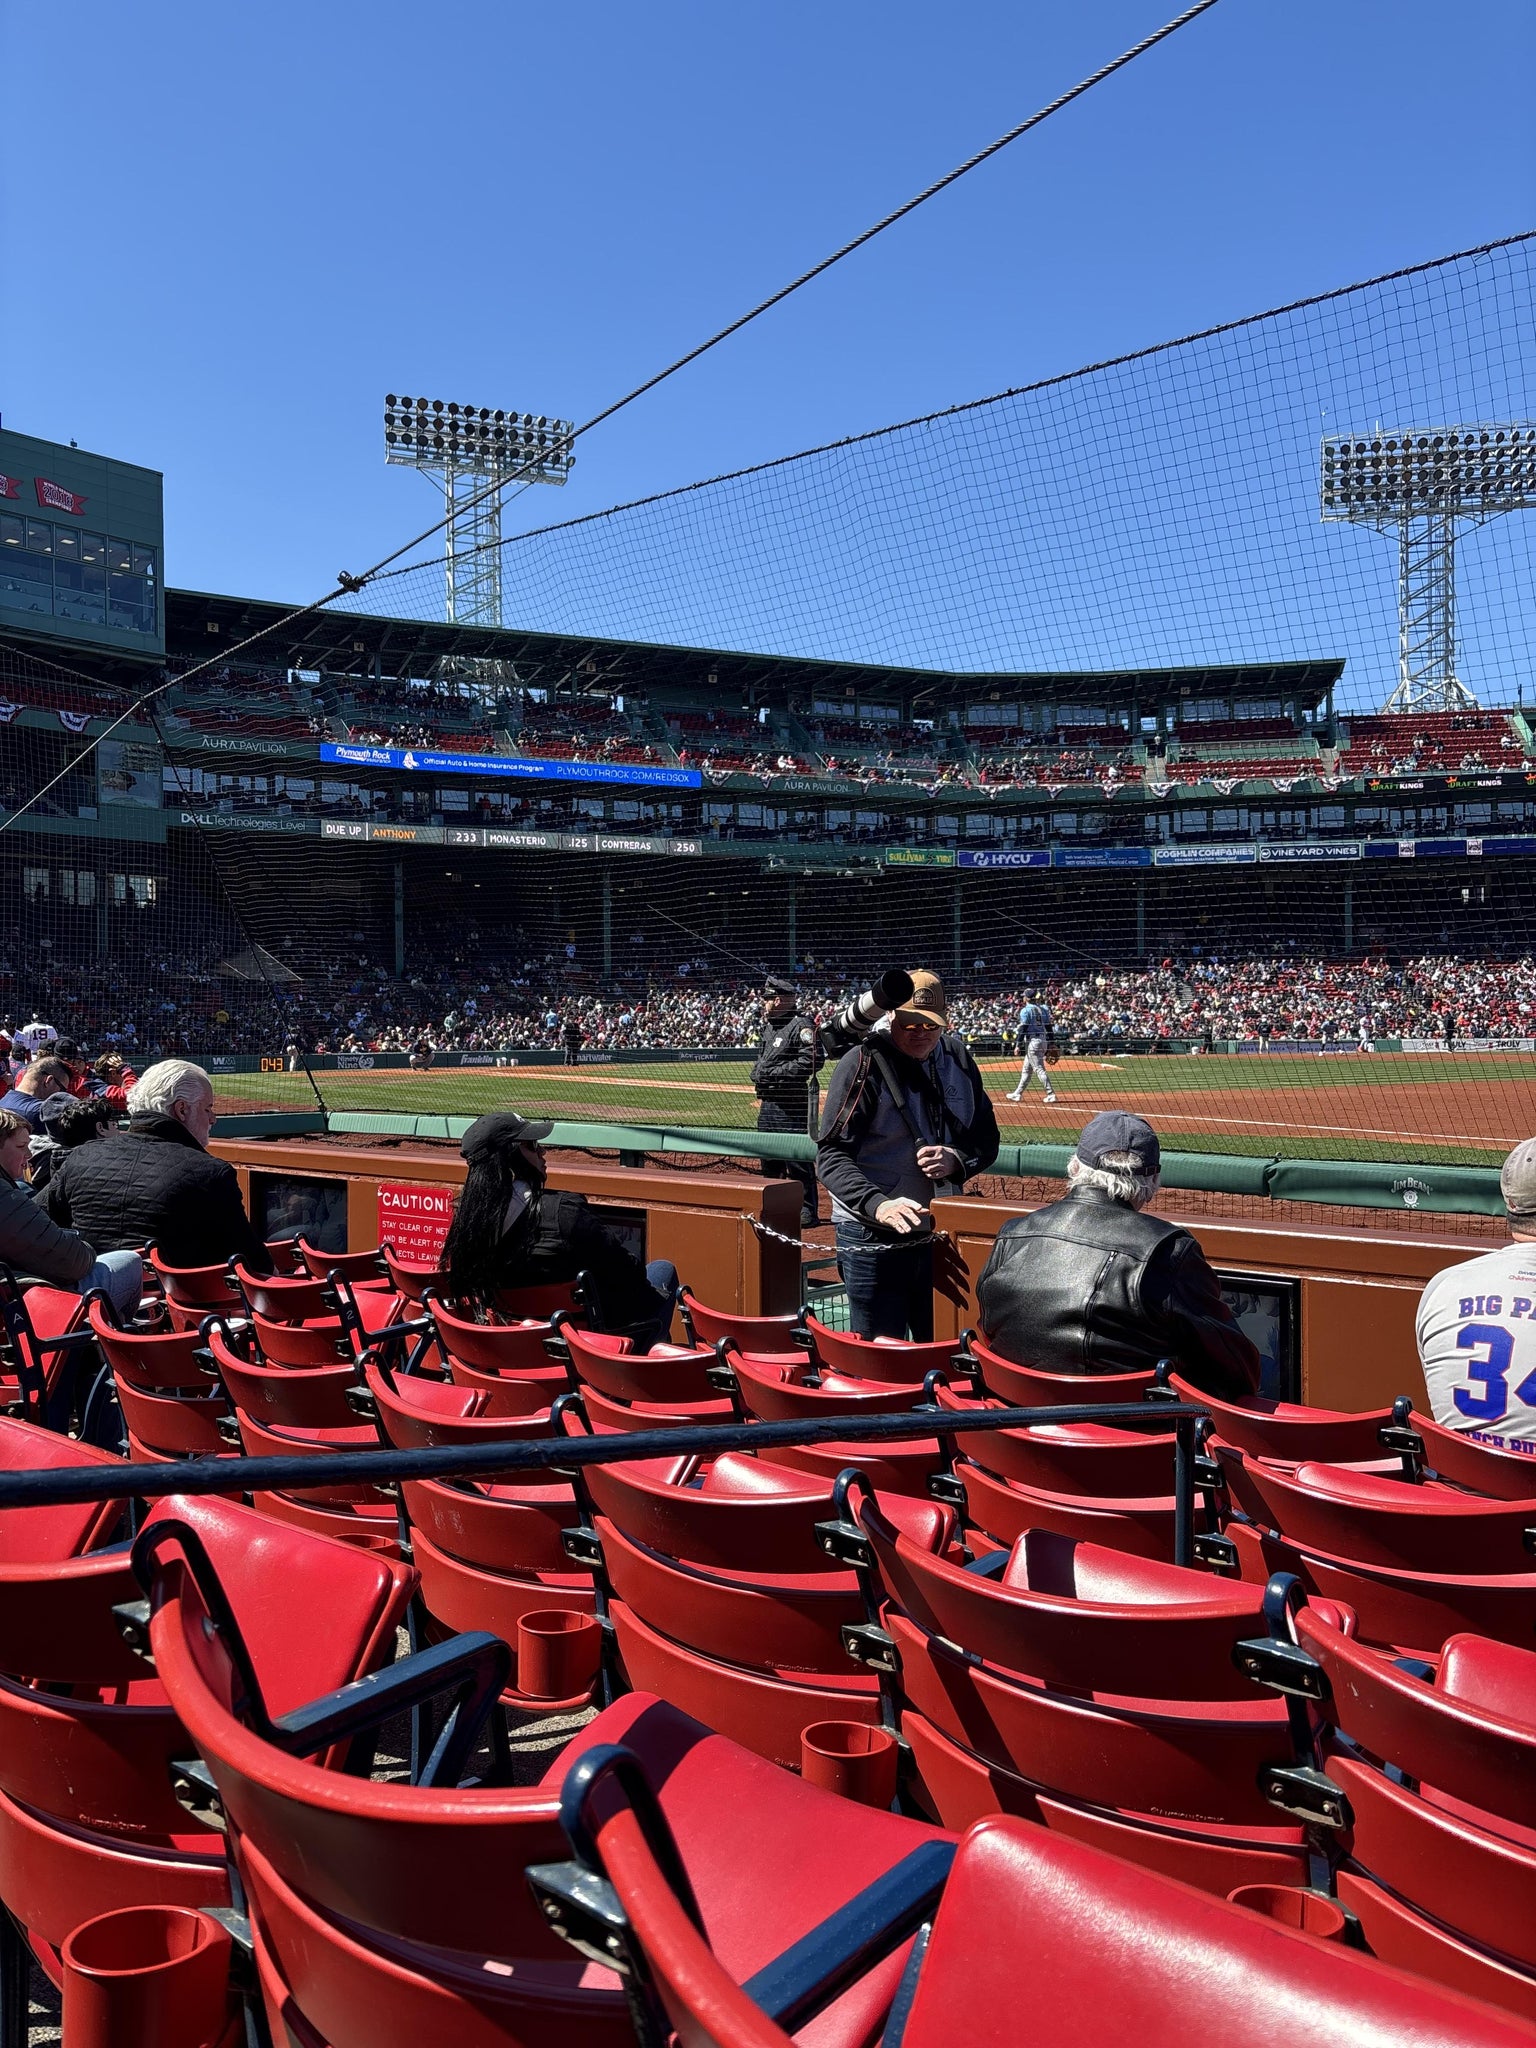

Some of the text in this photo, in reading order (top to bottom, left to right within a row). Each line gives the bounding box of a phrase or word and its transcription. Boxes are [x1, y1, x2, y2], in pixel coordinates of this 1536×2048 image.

[239, 740, 287, 754] PAVILION
[335, 746, 391, 760] Plymouth Rock
[423, 757, 447, 766] Official
[447, 759, 462, 767] Auto
[487, 762, 518, 770] Insurance
[518, 764, 544, 773] Program
[812, 782, 849, 793] PAVILION
[181, 812, 306, 831] DELL Technologies Level
[326, 824, 416, 840] DUE UP ANTHONY
[452, 832, 546, 846] .233 MONASTERIO
[568, 838, 651, 850] .125 CONTRERAS
[673, 843, 695, 853] .250
[1156, 849, 1198, 859] COGHLIN
[1198, 847, 1254, 857] COMPANIES
[1271, 846, 1358, 856] VINEYARD VINES
[889, 851, 926, 863] SULLIVAN
[992, 854, 1031, 864] HYCU
[33, 1029, 48, 1040] 19
[261, 1057, 283, 1072] 043
[460, 1053, 493, 1065] Franklin
[1390, 1176, 1431, 1196] JIM BEAM
[382, 1192, 449, 1213] CAUTION!
[382, 1220, 397, 1229] STAY
[399, 1222, 421, 1232] CLEAR
[423, 1225, 433, 1233] OF
[382, 1234, 396, 1243] AND
[398, 1235, 408, 1244] BE
[410, 1238, 431, 1247] ALERT
[417, 1252, 440, 1262] LEAVIN
[1458, 1294, 1503, 1319] BIG
[13, 1312, 24, 1325] A
[346, 1309, 355, 1321] 2
